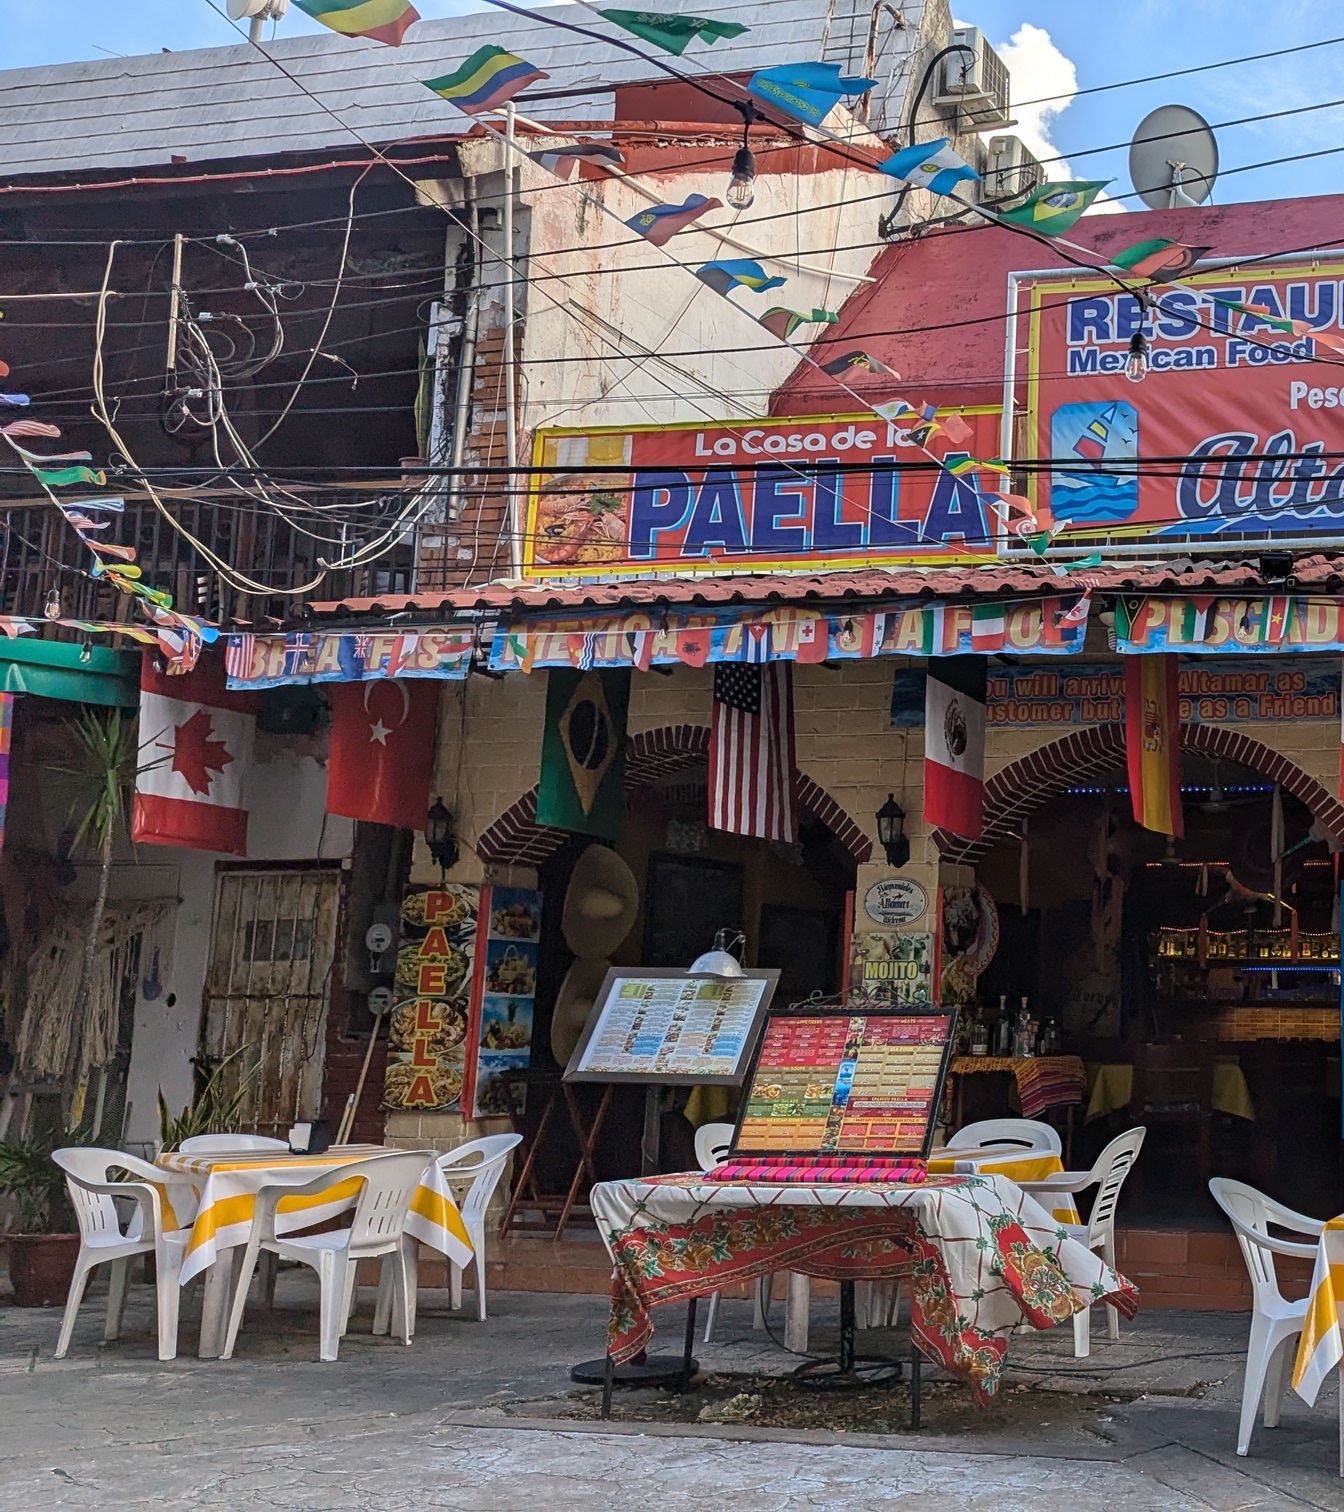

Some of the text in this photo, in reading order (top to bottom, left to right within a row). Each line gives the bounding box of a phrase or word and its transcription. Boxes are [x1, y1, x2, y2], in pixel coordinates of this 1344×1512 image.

[1225, 336, 1316, 367] Food
[695, 432, 736, 457] La
[742, 427, 827, 455] Casa
[831, 425, 877, 449] de
[628, 452, 993, 559] PAELLA
[1015, 673, 1059, 698] will
[1065, 673, 1127, 698] arriv
[1178, 670, 1270, 694] Altamar
[1276, 672, 1306, 692] as
[985, 699, 1074, 722] ustomer
[1080, 697, 1121, 721] but
[1199, 698, 1228, 718] as
[1235, 698, 1251, 718] a
[1258, 691, 1337, 718] Friend
[863, 960, 919, 981] MOJITO
[403, 890, 455, 1107] PAELLA
